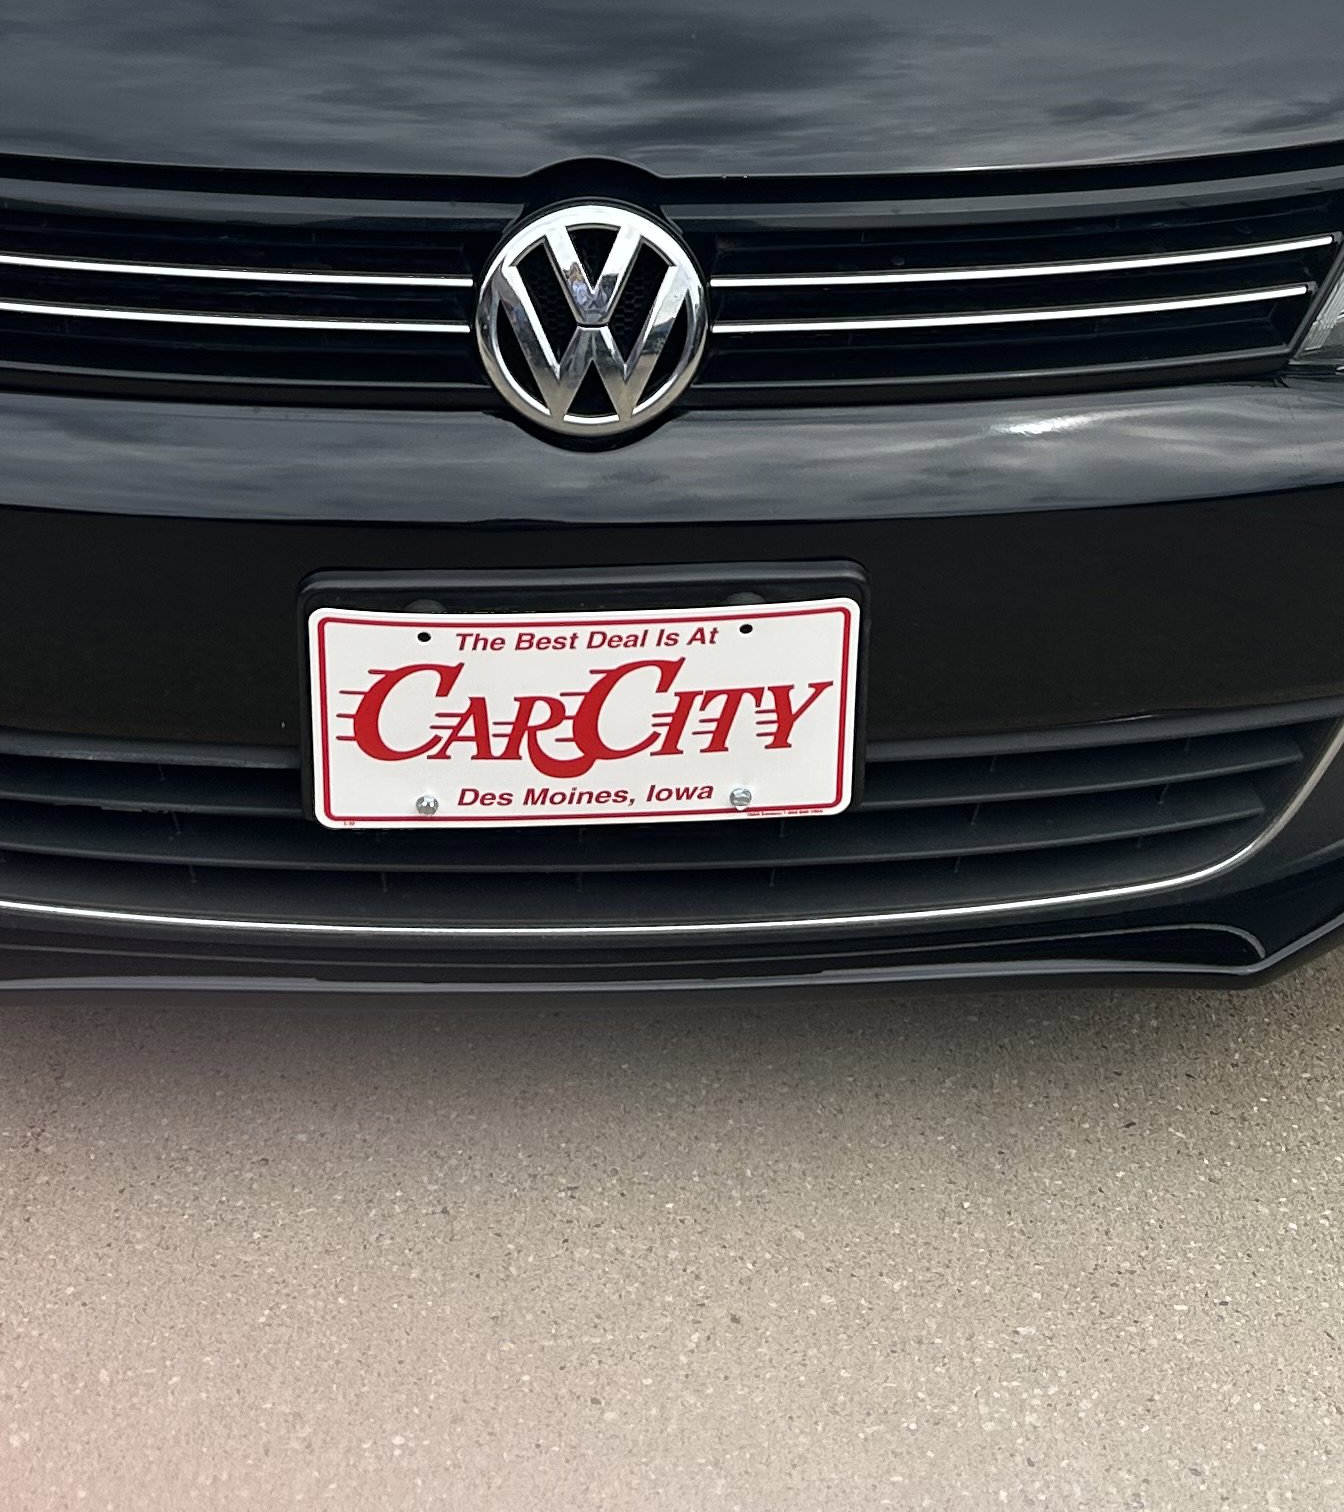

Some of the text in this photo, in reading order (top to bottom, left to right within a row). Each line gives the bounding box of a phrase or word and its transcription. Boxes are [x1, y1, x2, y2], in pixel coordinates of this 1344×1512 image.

[486, 212, 700, 428] VW
[455, 626, 719, 651] The Best Deal Is At
[457, 784, 715, 807] Des Moines, Iowa
